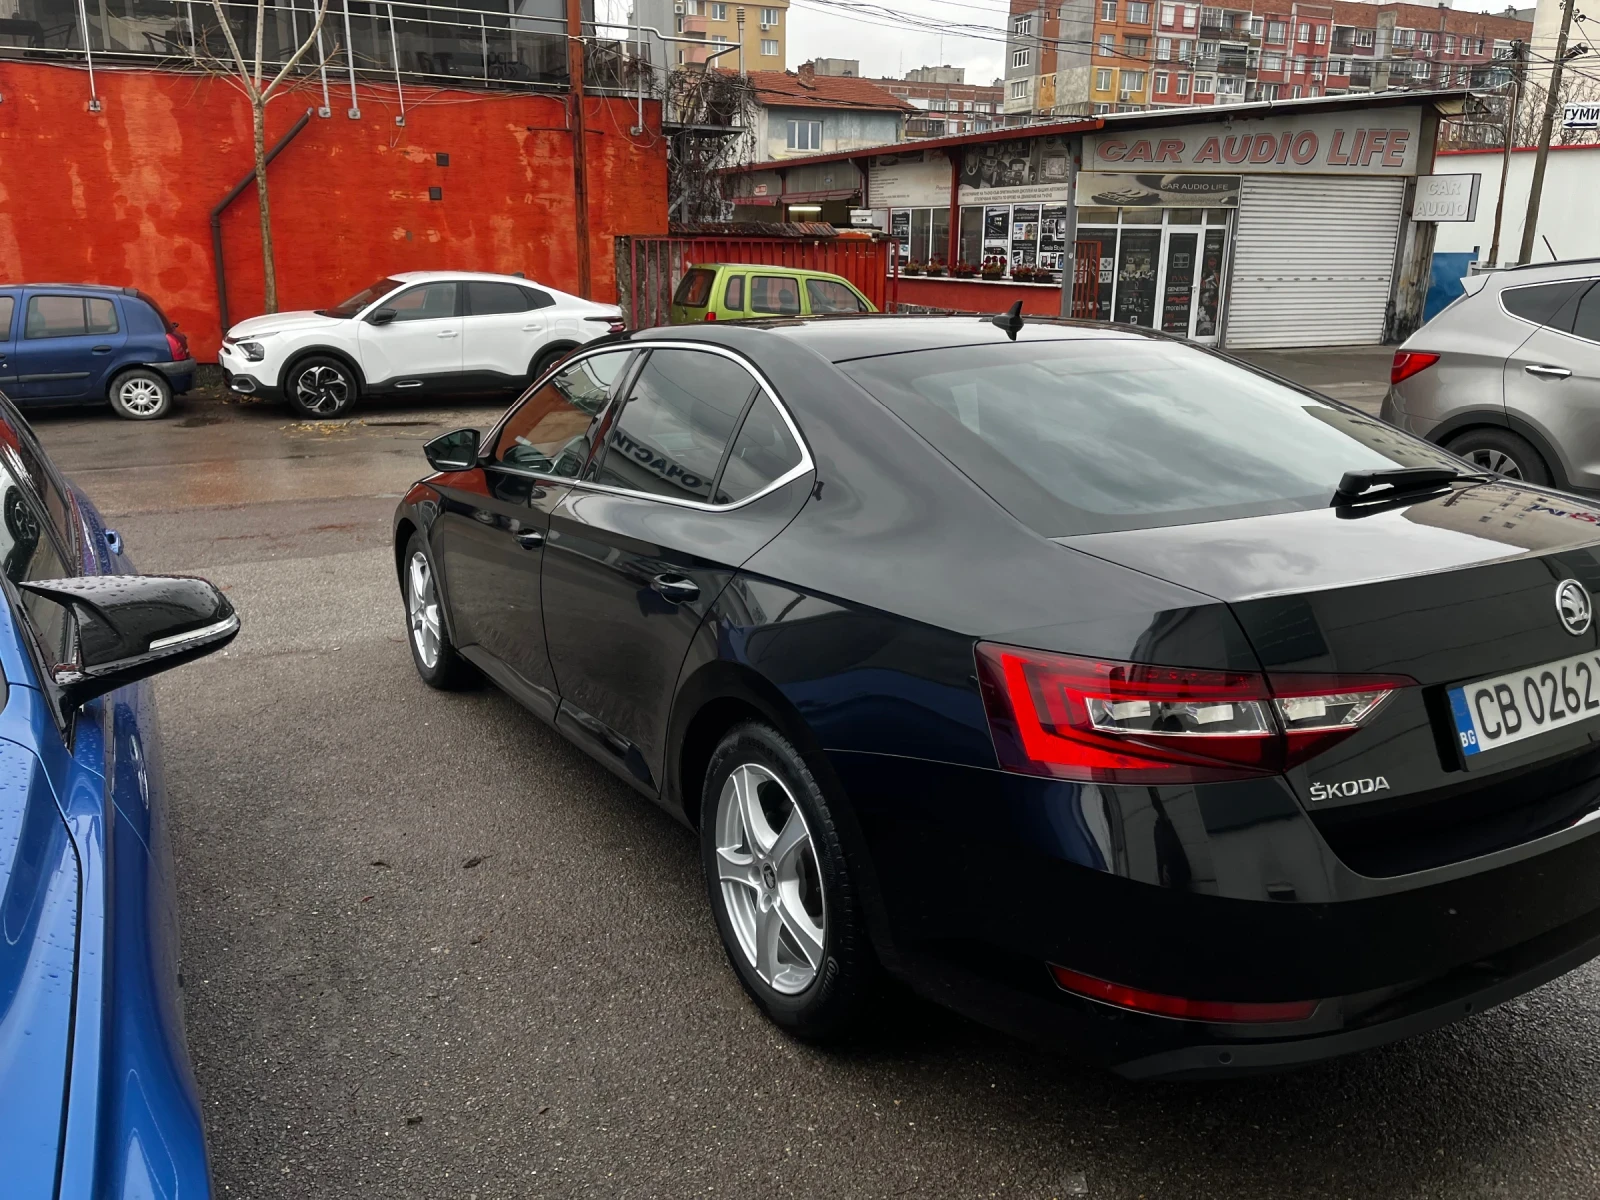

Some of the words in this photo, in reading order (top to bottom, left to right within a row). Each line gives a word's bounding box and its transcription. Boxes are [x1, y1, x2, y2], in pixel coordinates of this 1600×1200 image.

[1563, 108, 1600, 121] ГУМИ
[1096, 139, 1185, 163] CAR
[1192, 130, 1319, 165] AUDIO
[1326, 128, 1411, 167] LIFE
[1426, 179, 1462, 196] CAR
[1414, 201, 1468, 217] AUDIO
[1473, 683, 1522, 740] CB
[1523, 661, 1600, 725] 0262
[1459, 729, 1476, 748] BG
[1309, 776, 1390, 801] ŠKODA
